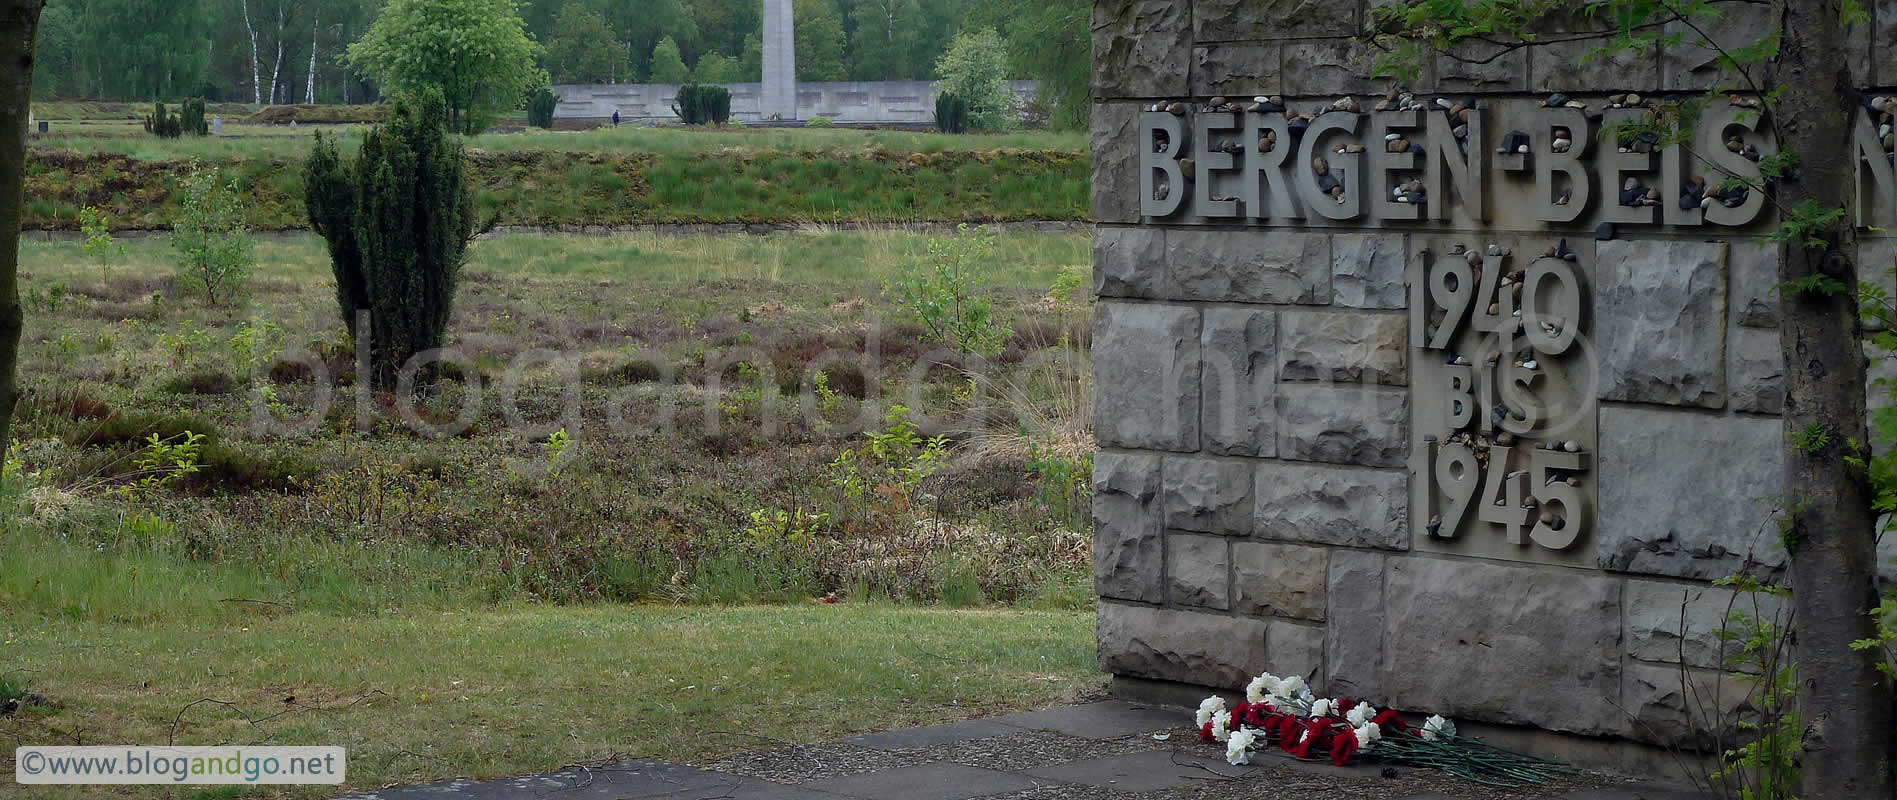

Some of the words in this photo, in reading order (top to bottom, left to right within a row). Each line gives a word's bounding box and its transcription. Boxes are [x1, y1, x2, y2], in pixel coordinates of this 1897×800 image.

[1139, 109, 1897, 228] BERGEN-BELSN
[1405, 252, 1580, 356] 1940
[1446, 361, 1545, 434] BIS
[1406, 441, 1589, 549] 1945
